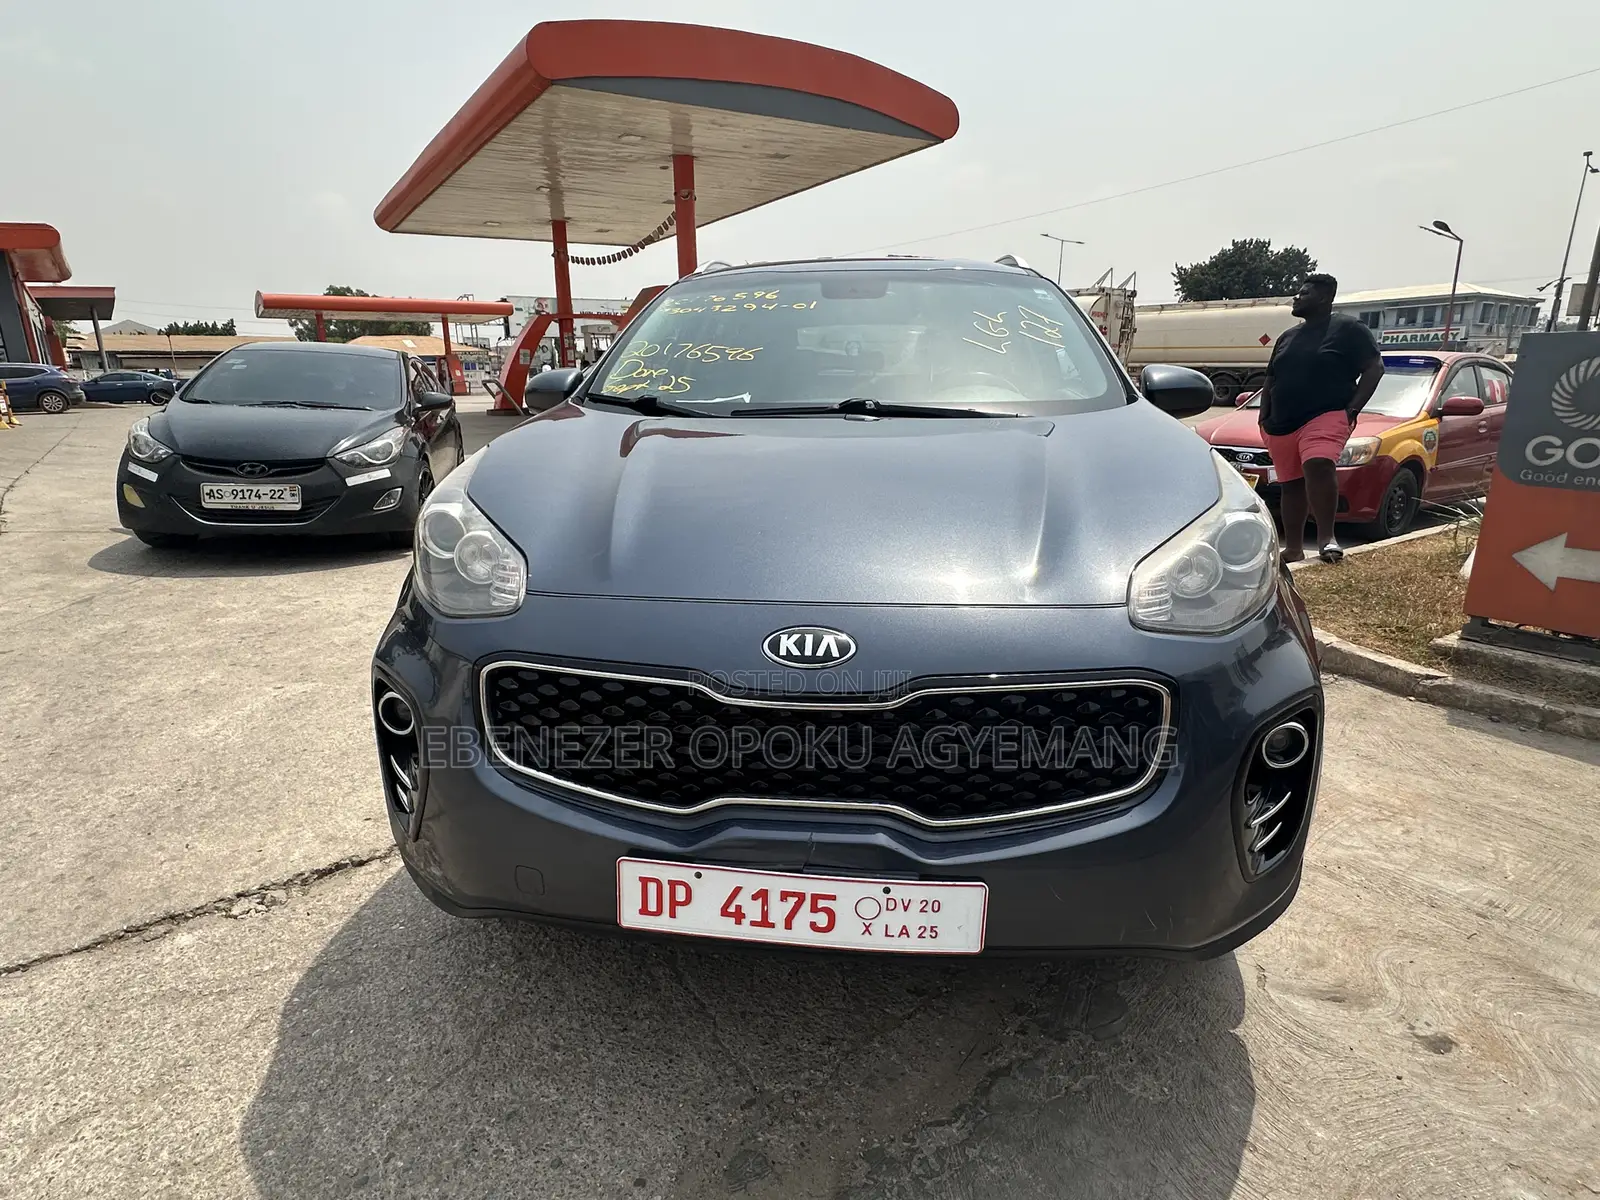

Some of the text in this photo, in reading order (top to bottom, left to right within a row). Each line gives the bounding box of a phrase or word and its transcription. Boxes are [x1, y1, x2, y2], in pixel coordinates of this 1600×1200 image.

[208, 488, 285, 500] AS 9174-22
[779, 633, 840, 658] KIA
[638, 875, 837, 934] DP 4175
[885, 898, 941, 914] DV 20
[860, 922, 940, 940] X LA 25
